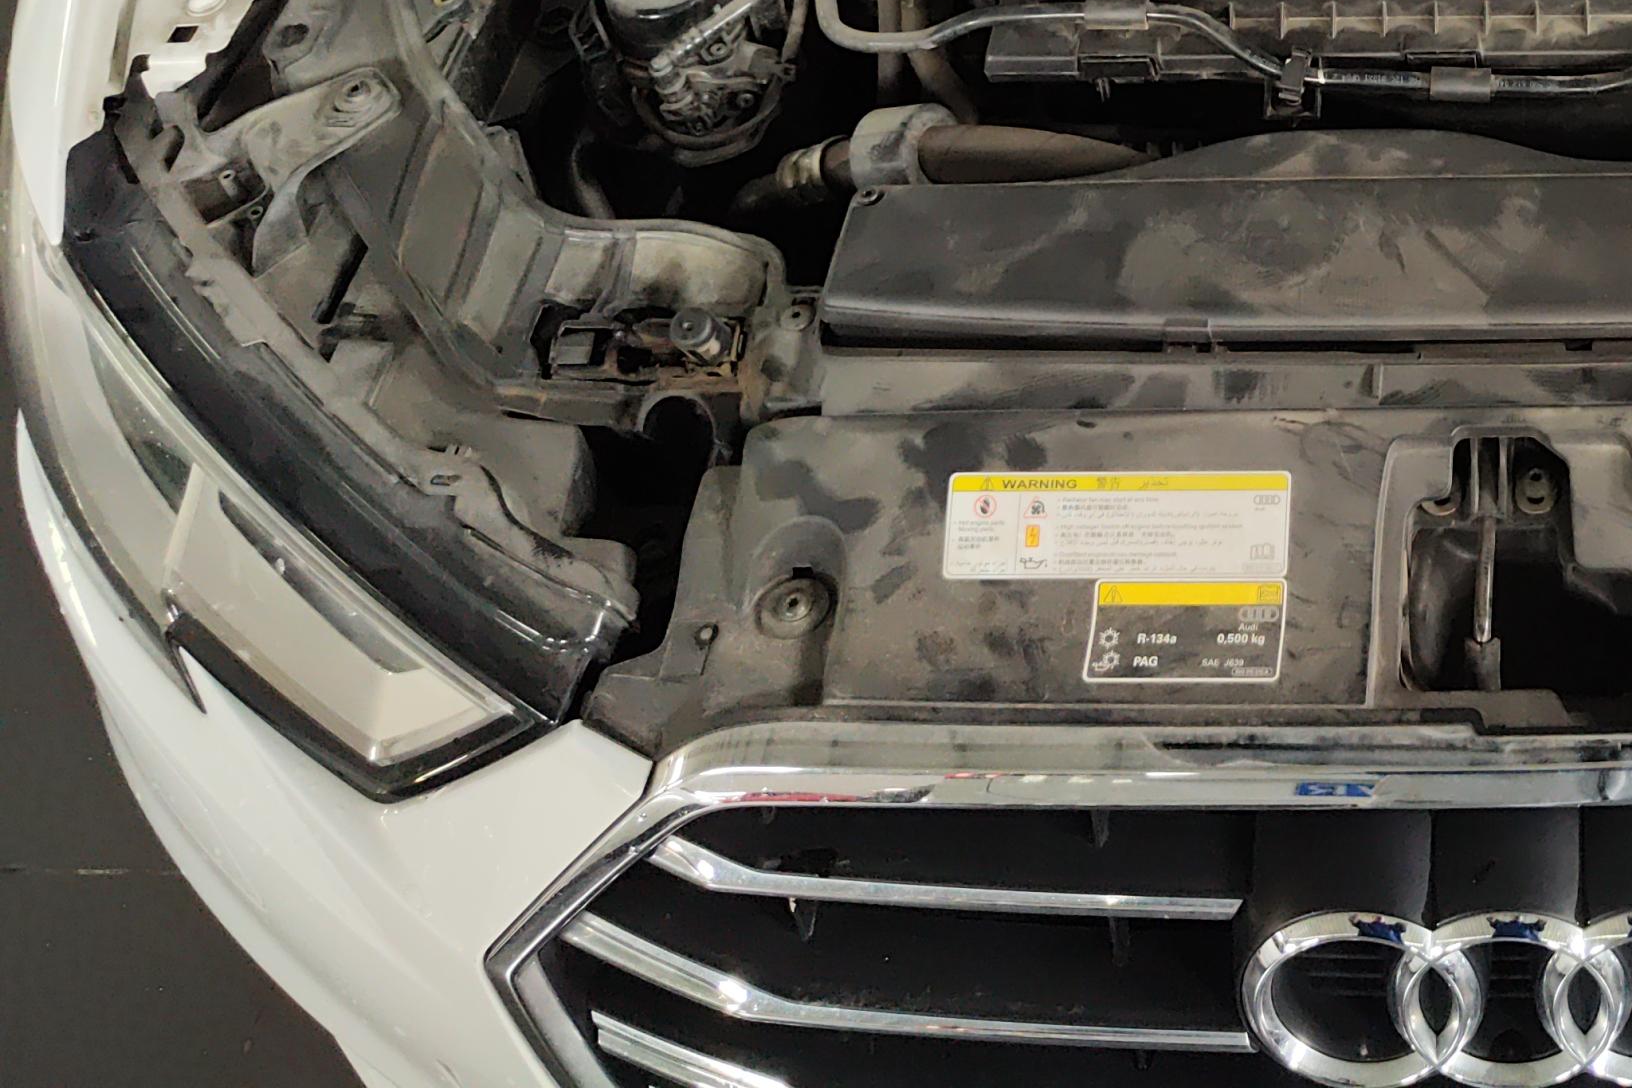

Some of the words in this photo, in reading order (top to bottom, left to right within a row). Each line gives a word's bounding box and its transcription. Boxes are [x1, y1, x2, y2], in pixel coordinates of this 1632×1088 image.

[1002, 479, 1078, 489] WARNING
[1238, 623, 1258, 631] Audi
[1136, 633, 1177, 644] R-134a
[1216, 633, 1249, 645] 0,500
[1251, 633, 1266, 646] kg
[1132, 655, 1158, 667] PAG
